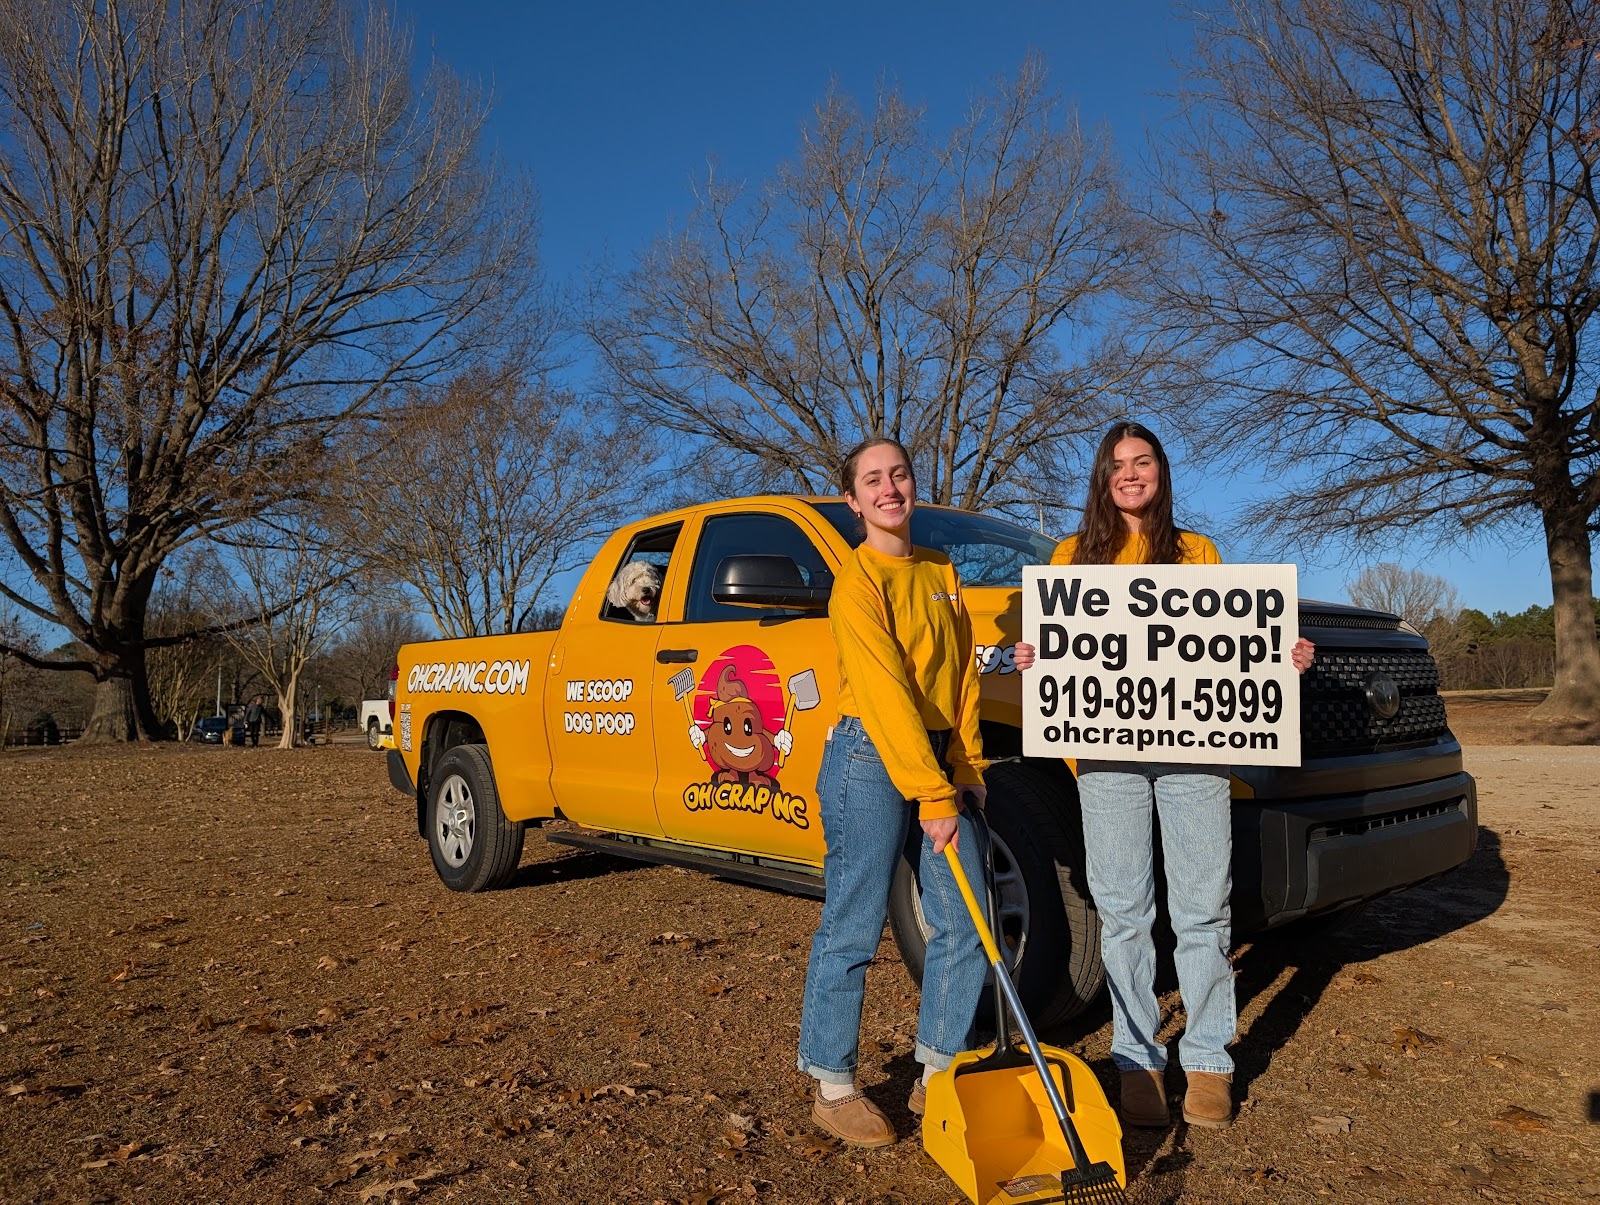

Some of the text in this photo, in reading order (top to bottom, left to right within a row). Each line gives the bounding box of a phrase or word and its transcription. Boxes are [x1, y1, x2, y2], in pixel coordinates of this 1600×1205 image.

[1037, 578, 1285, 628] We Scoop
[1040, 624, 1282, 672] Dog Poop!
[407, 659, 531, 695] OHCRAPNC.COM
[566, 679, 633, 702] WE SCOOP
[1039, 675, 1283, 723] 919-891-5999
[564, 712, 635, 735] DOG POOP
[1043, 721, 1278, 751] ohcrapnc.com
[683, 780, 810, 830] OH CRAP NC
